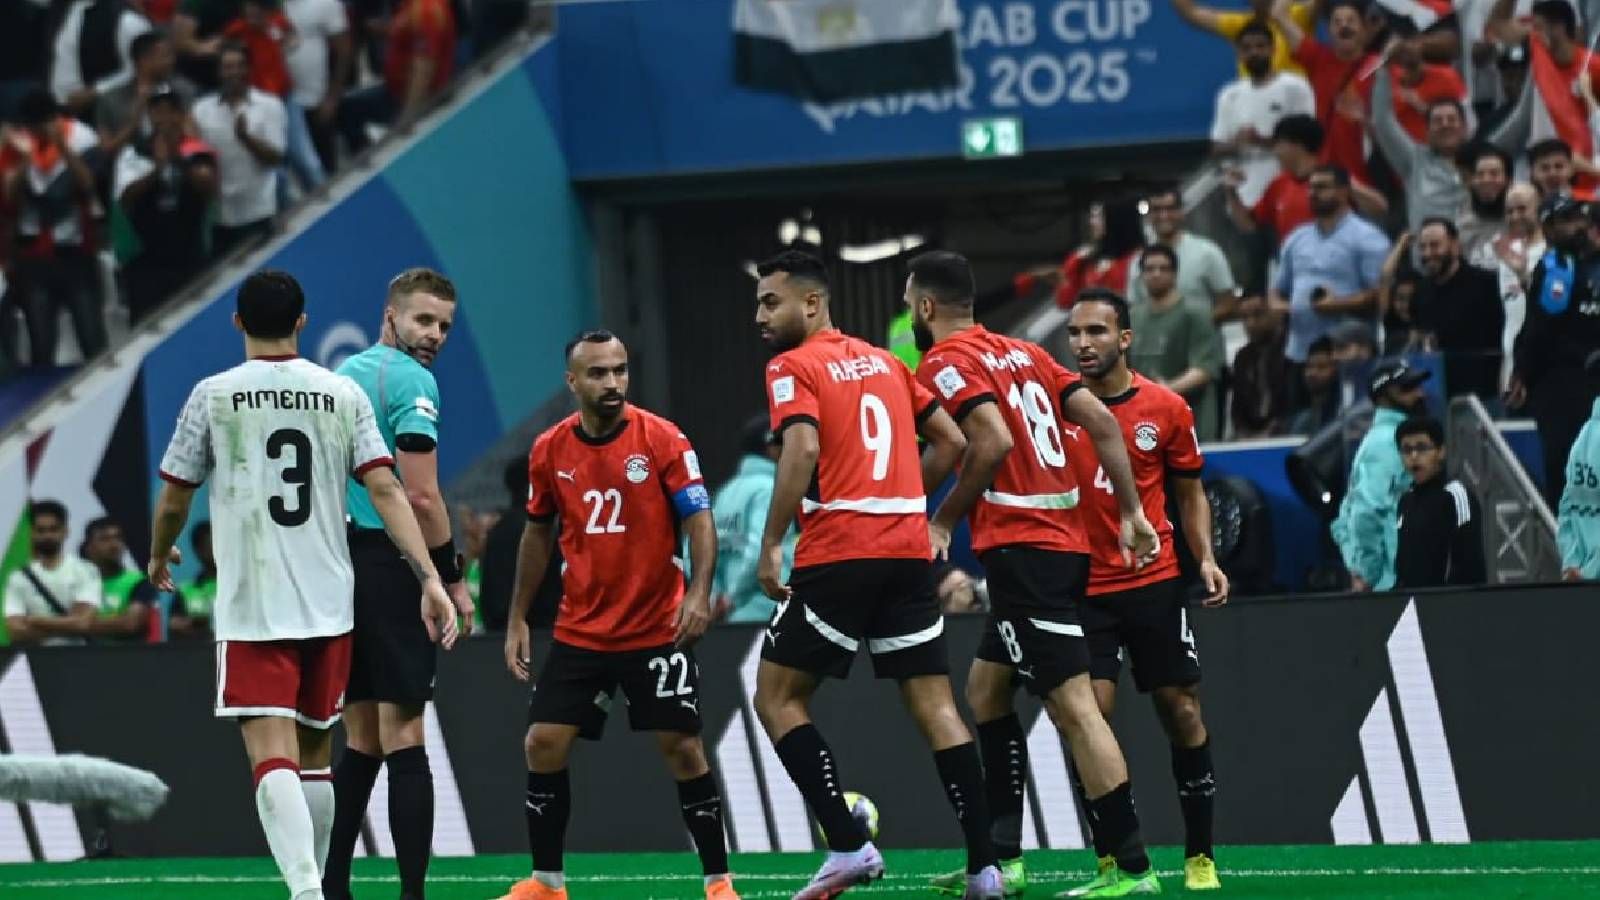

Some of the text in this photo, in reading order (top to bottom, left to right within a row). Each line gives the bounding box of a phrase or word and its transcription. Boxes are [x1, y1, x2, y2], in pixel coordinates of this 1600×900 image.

[956, 0, 1152, 47] AB CUP
[989, 50, 1131, 107] 2025
[232, 388, 335, 413] PIMENTA
[860, 392, 892, 481] 9
[1006, 380, 1066, 470] 18
[265, 428, 312, 527] 3
[1093, 463, 1114, 495] 4
[583, 488, 626, 534] 22
[1180, 606, 1195, 650] 4
[648, 652, 693, 698] 22
